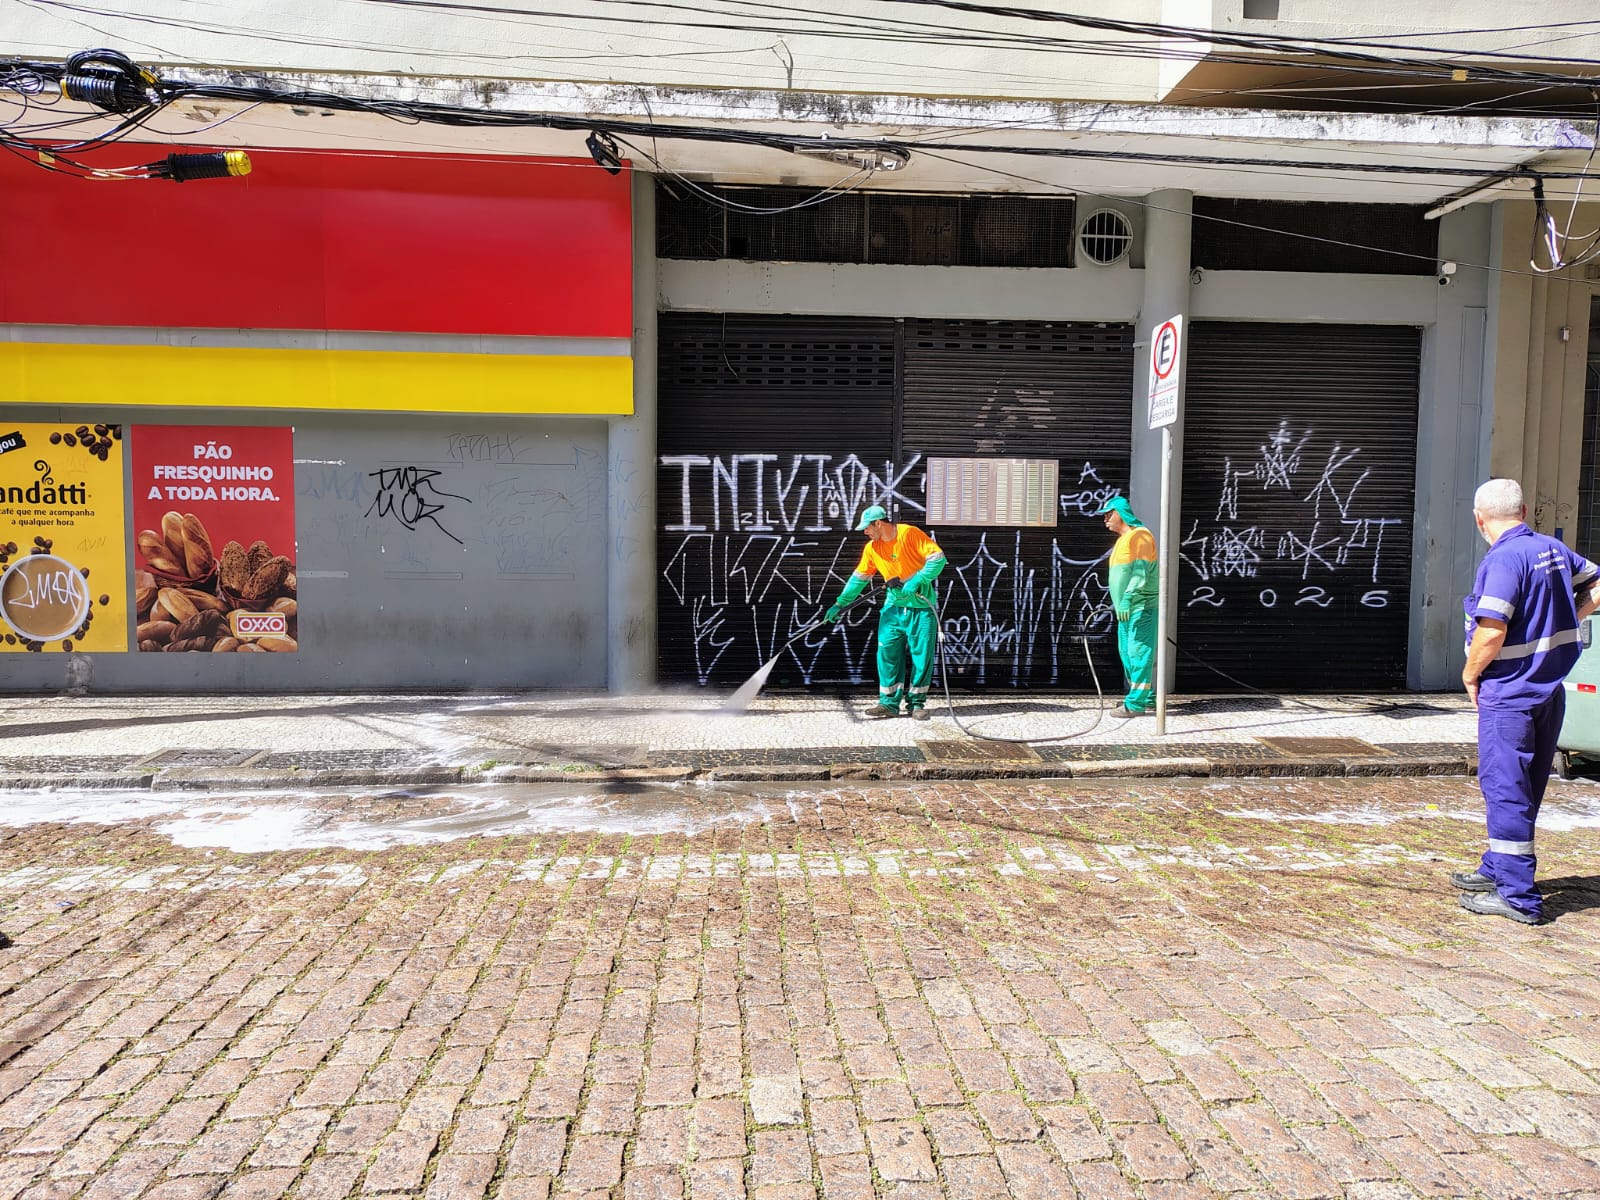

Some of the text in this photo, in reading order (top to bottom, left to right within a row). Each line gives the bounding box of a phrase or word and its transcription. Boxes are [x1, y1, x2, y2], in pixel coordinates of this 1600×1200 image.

[1161, 334, 1171, 365] E
[193, 441, 232, 459] PÃO
[154, 465, 273, 483] FRESQUINHO
[147, 486, 280, 501] A TODA HORA.
[49, 509, 95, 517] acompanha
[18, 518, 54, 527] qualquer
[57, 518, 74, 526] hora
[239, 616, 284, 632] OXXO
